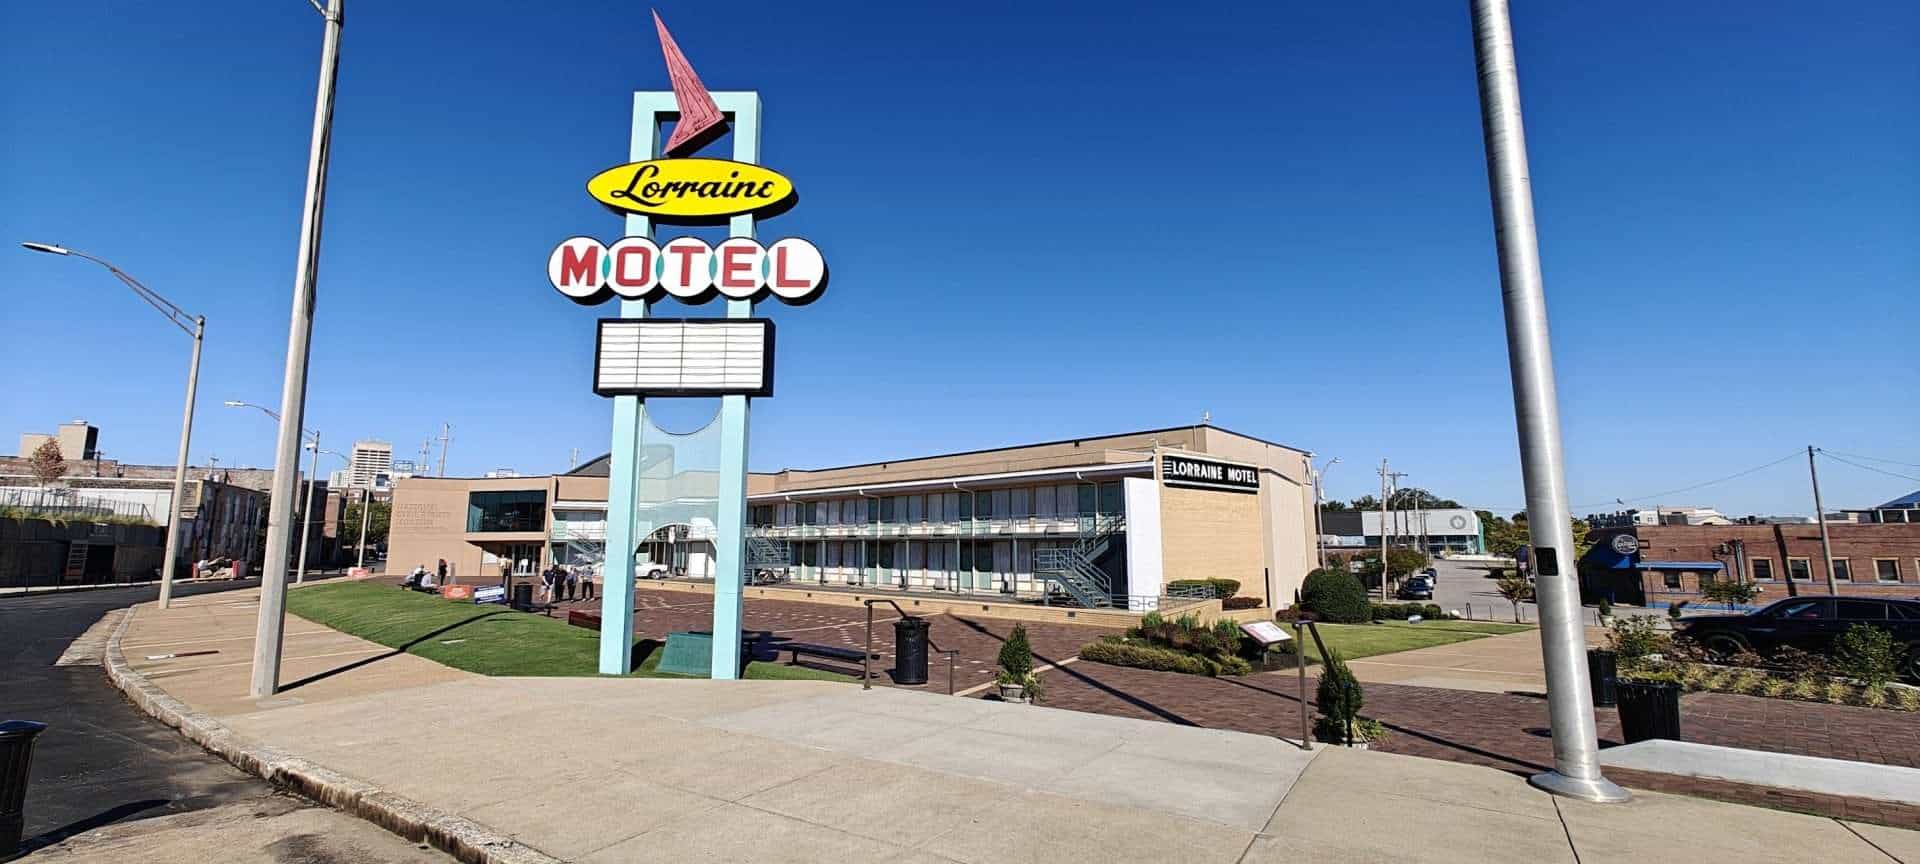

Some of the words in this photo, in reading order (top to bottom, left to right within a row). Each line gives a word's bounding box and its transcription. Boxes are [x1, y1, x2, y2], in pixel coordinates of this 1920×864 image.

[611, 165, 774, 207] Lorraine
[559, 245, 811, 288] MOTEL
[1173, 461, 1222, 480] LORRAINE
[1227, 467, 1257, 484] MOTEL
